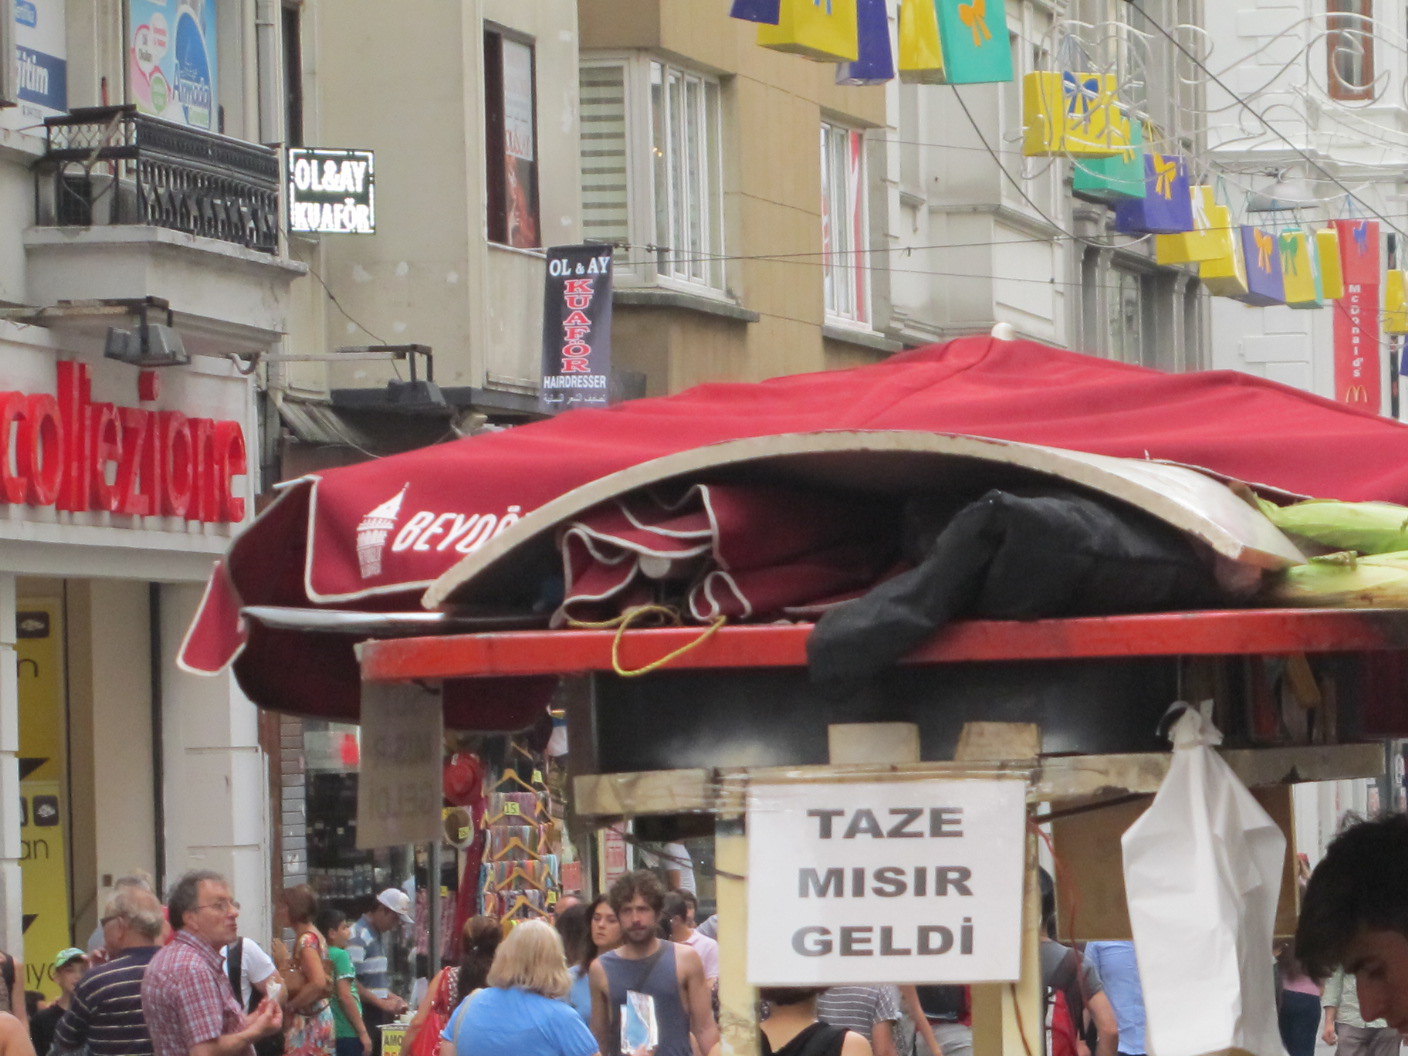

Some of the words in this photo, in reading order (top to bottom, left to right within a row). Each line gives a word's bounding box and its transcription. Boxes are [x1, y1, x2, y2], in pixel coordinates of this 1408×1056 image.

[294, 158, 367, 192] OL&AY
[294, 197, 370, 231] KUAFÖR
[549, 258, 571, 276] OL
[575, 262, 585, 275] &
[587, 256, 610, 274] AY
[561, 278, 594, 374] KUAFÖR
[1348, 284, 1364, 378] McDonald's
[543, 374, 607, 390] HAIRDRESSER
[806, 807, 964, 839] TAZE
[799, 865, 974, 898] MISIR
[791, 916, 974, 957] GELDİ
